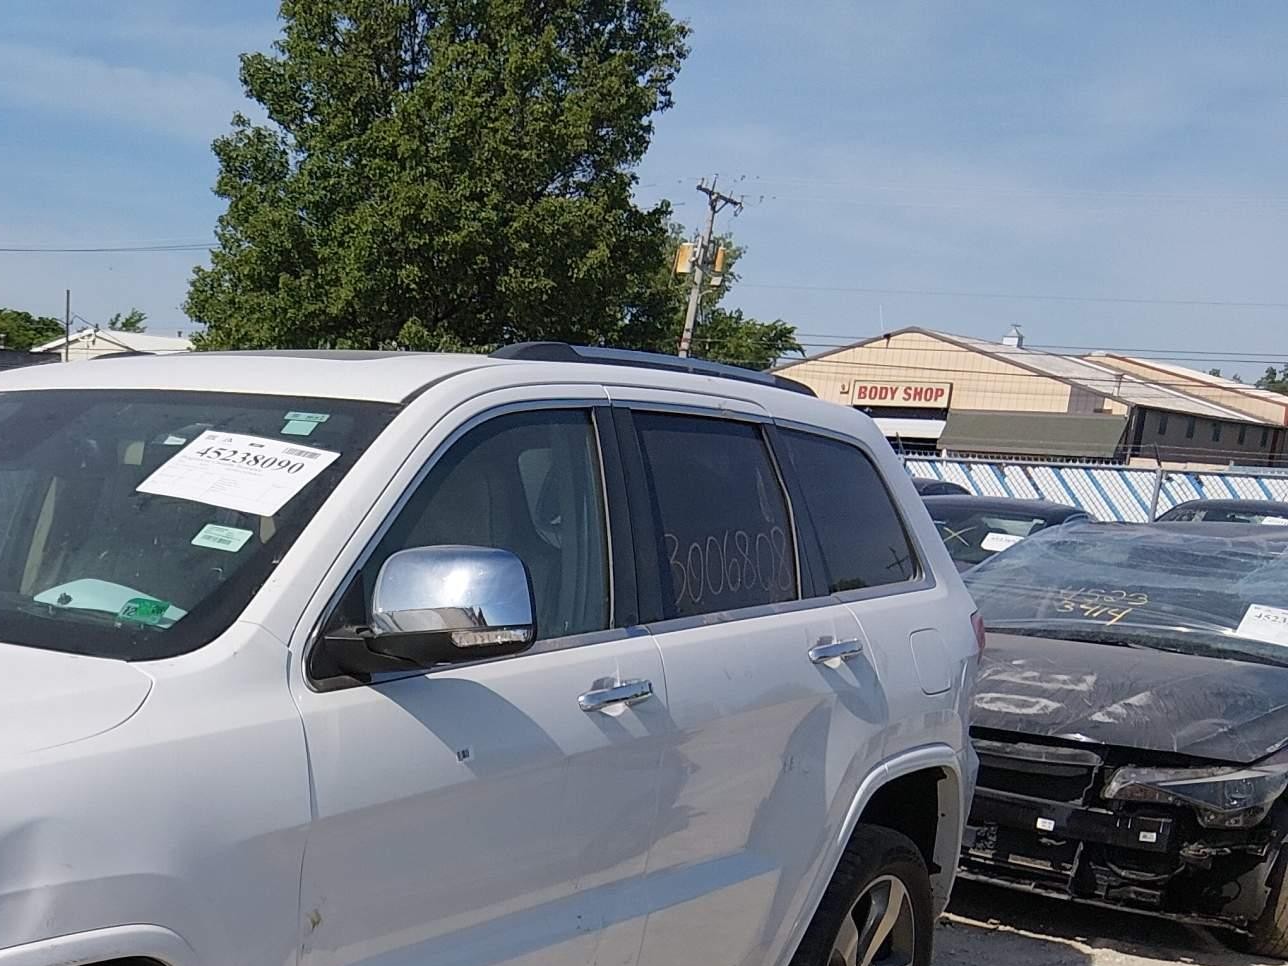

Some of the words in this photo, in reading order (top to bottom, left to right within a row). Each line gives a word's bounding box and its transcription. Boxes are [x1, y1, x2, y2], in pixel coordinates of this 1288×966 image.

[857, 385, 899, 401] BODY
[902, 386, 945, 402] SHOP
[196, 446, 305, 474] 45238090
[663, 526, 792, 607] 3006808
